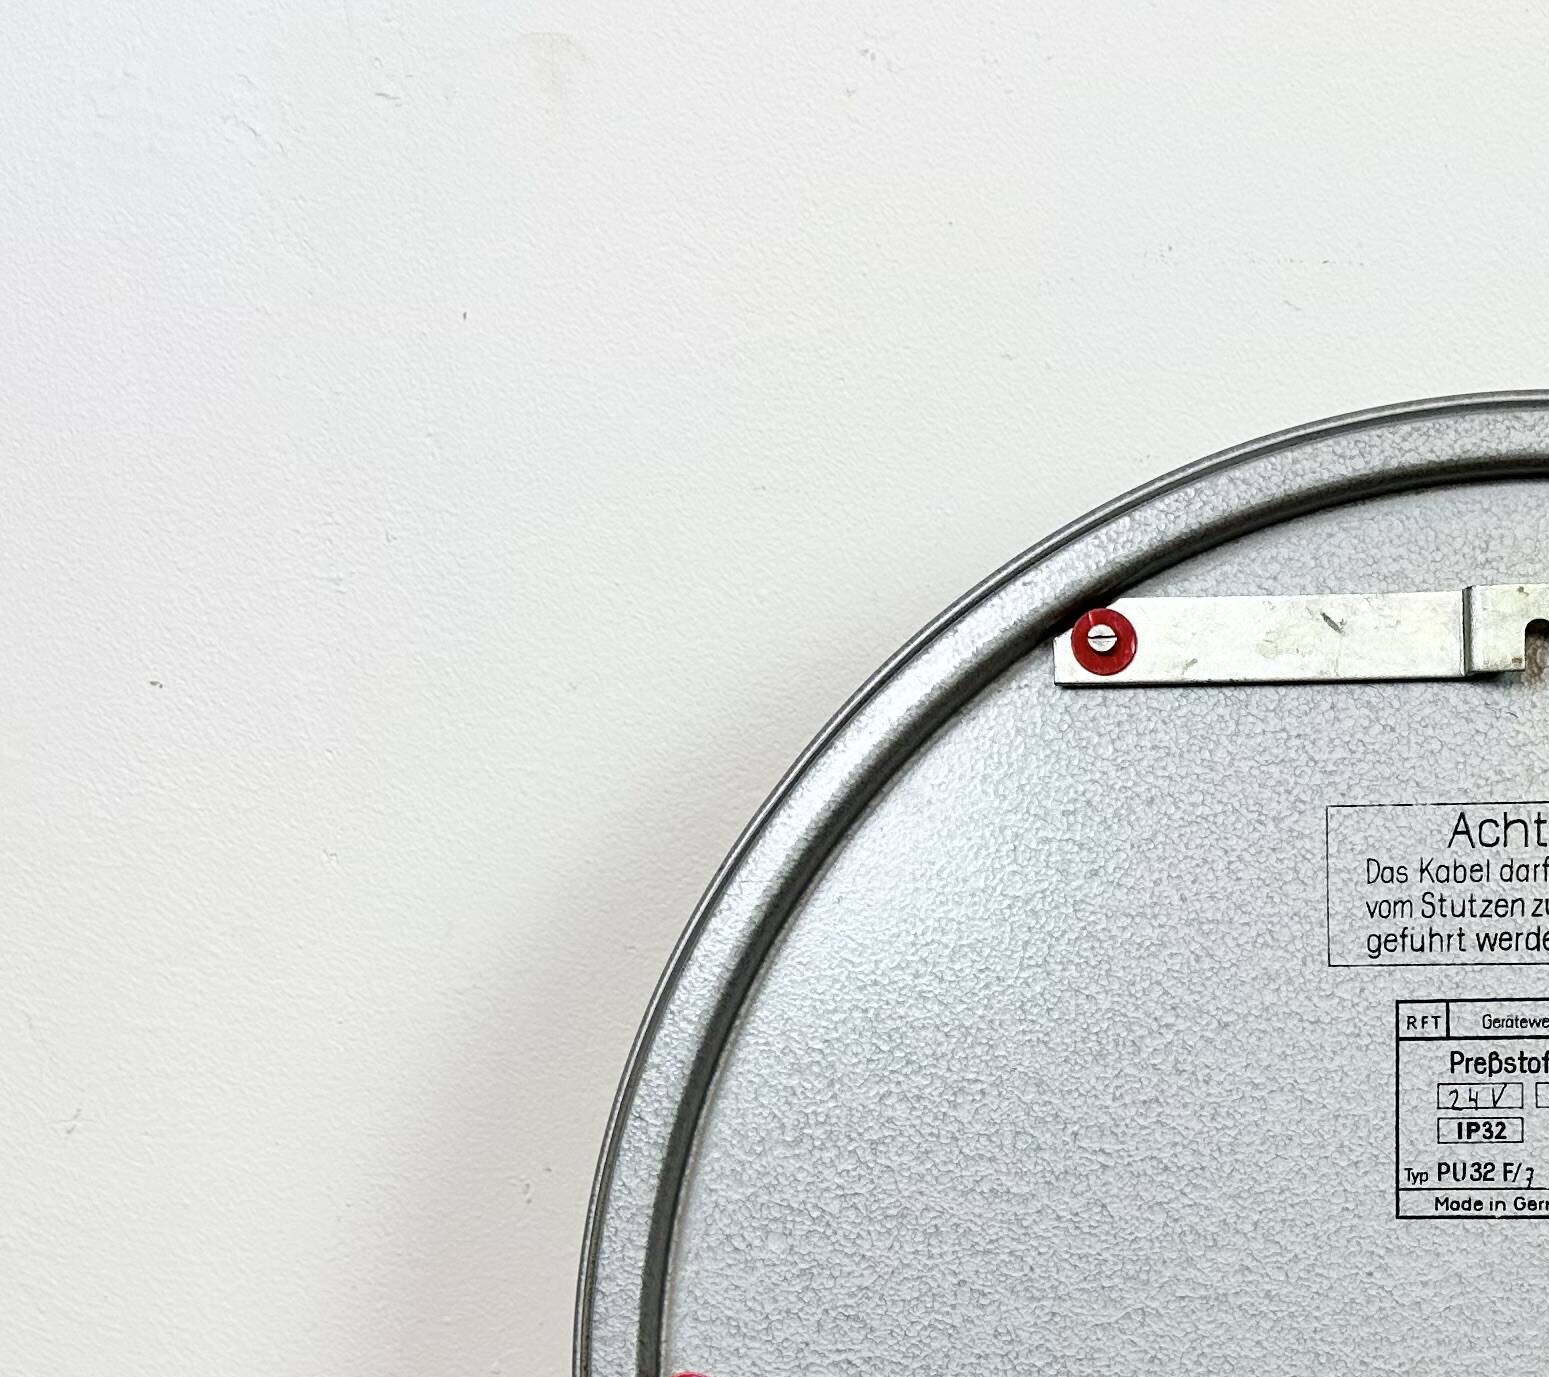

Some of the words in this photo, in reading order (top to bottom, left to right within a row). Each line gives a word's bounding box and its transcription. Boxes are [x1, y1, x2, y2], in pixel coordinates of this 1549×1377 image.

[1366, 857, 1409, 885] Das
[1419, 856, 1491, 885] Kabel
[1366, 897, 1414, 920] vom
[1421, 892, 1526, 919] Stutzen
[1456, 1120, 1508, 1141] IP32
[1404, 1167, 1429, 1186] Typ
[1434, 1196, 1484, 1212] Made
[1489, 1196, 1507, 1212] in
